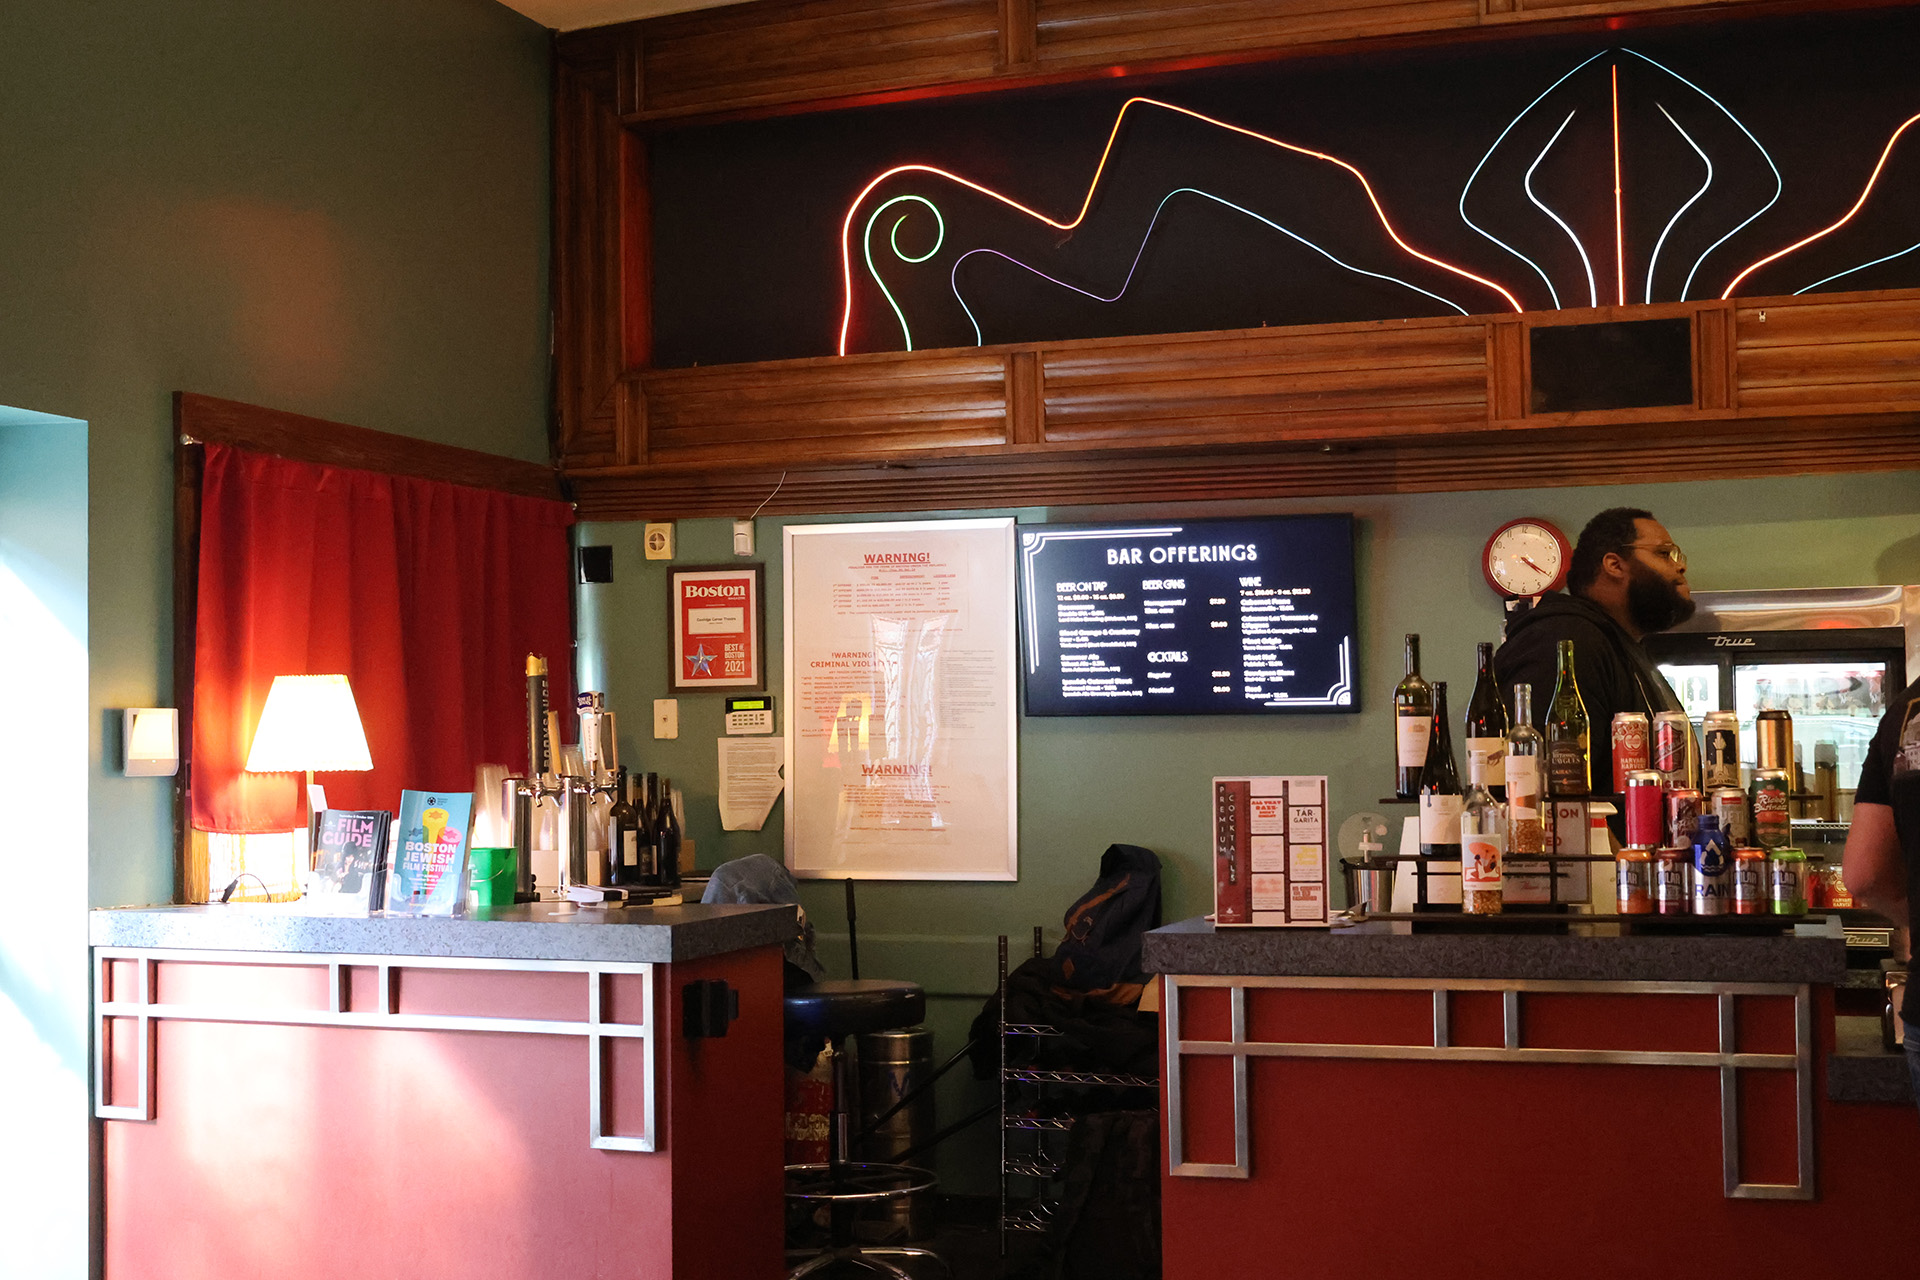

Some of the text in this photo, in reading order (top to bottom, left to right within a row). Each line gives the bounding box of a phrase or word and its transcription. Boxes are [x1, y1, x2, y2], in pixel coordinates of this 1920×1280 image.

[864, 552, 930, 564] WARNING!
[1107, 544, 1258, 565] BAR OFFERINGS
[1057, 582, 1107, 592] BEER ON TAP
[1142, 579, 1186, 590] BEER CANS
[1240, 577, 1261, 586] WINE
[685, 584, 746, 598] Boston
[1708, 636, 1756, 646] true
[1148, 652, 1188, 662] COCKTAILS
[725, 660, 744, 672] 2021
[862, 764, 932, 774] WARNING!
[338, 818, 373, 833] FILM
[322, 831, 372, 847] GUIDE
[405, 841, 456, 853] BOSTON
[403, 851, 455, 864] JEWISH
[402, 862, 453, 872] FILM FESTIVAL
